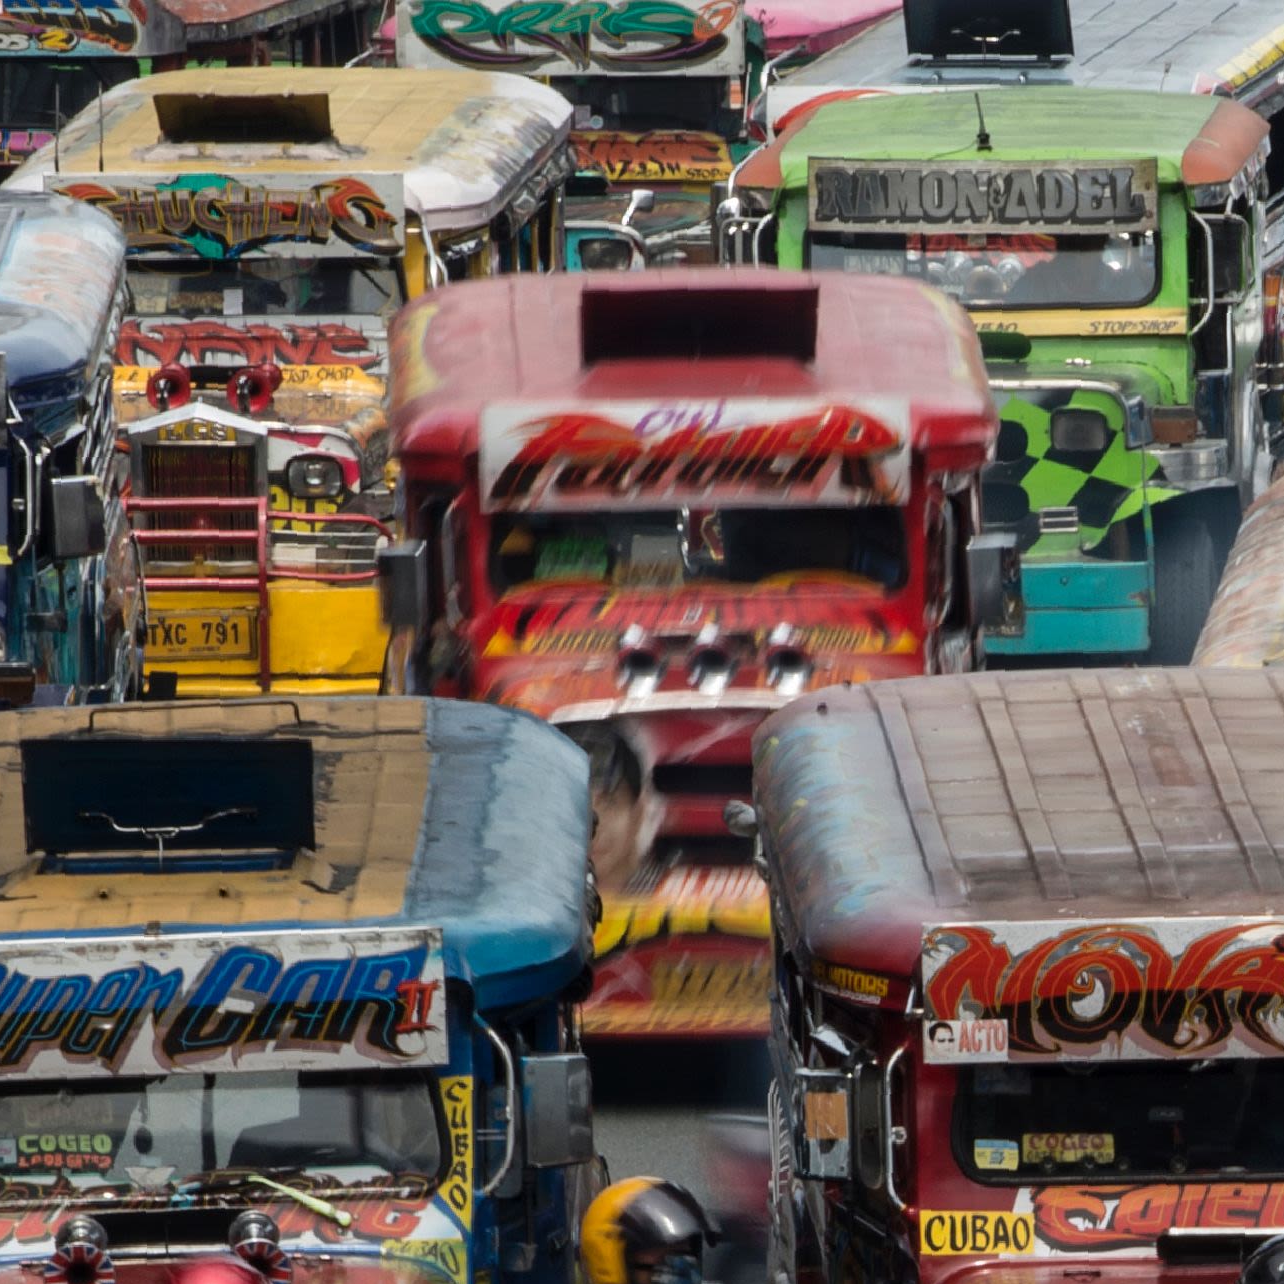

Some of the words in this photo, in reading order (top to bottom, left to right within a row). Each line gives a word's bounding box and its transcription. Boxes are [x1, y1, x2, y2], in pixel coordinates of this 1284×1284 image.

[201, 623, 240, 645] 791
[18, 1134, 112, 1154] COGEO
[1028, 1134, 1105, 1150] COGEO
[924, 1214, 1031, 1254] CUBAO
